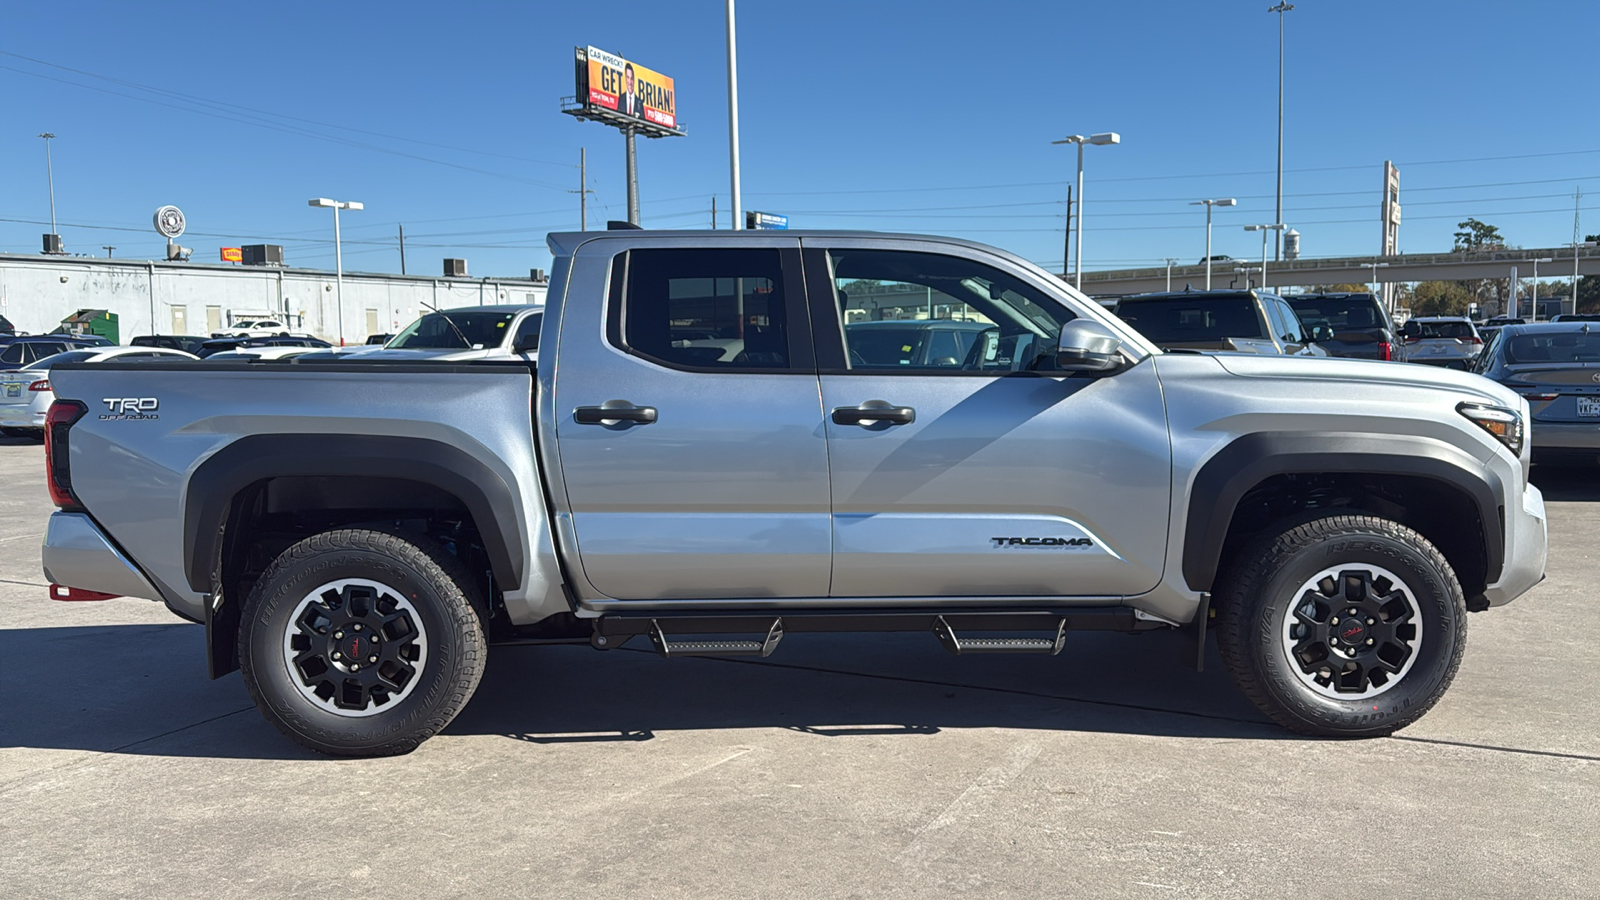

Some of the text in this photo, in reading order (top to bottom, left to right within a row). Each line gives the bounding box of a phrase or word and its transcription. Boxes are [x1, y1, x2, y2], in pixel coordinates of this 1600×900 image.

[590, 49, 601, 60] CAR
[602, 54, 623, 68] WRECK?
[601, 65, 623, 96] GET
[638, 78, 674, 114] BRIAN!
[102, 397, 158, 414] TRD
[991, 537, 1094, 547] TACOMA
